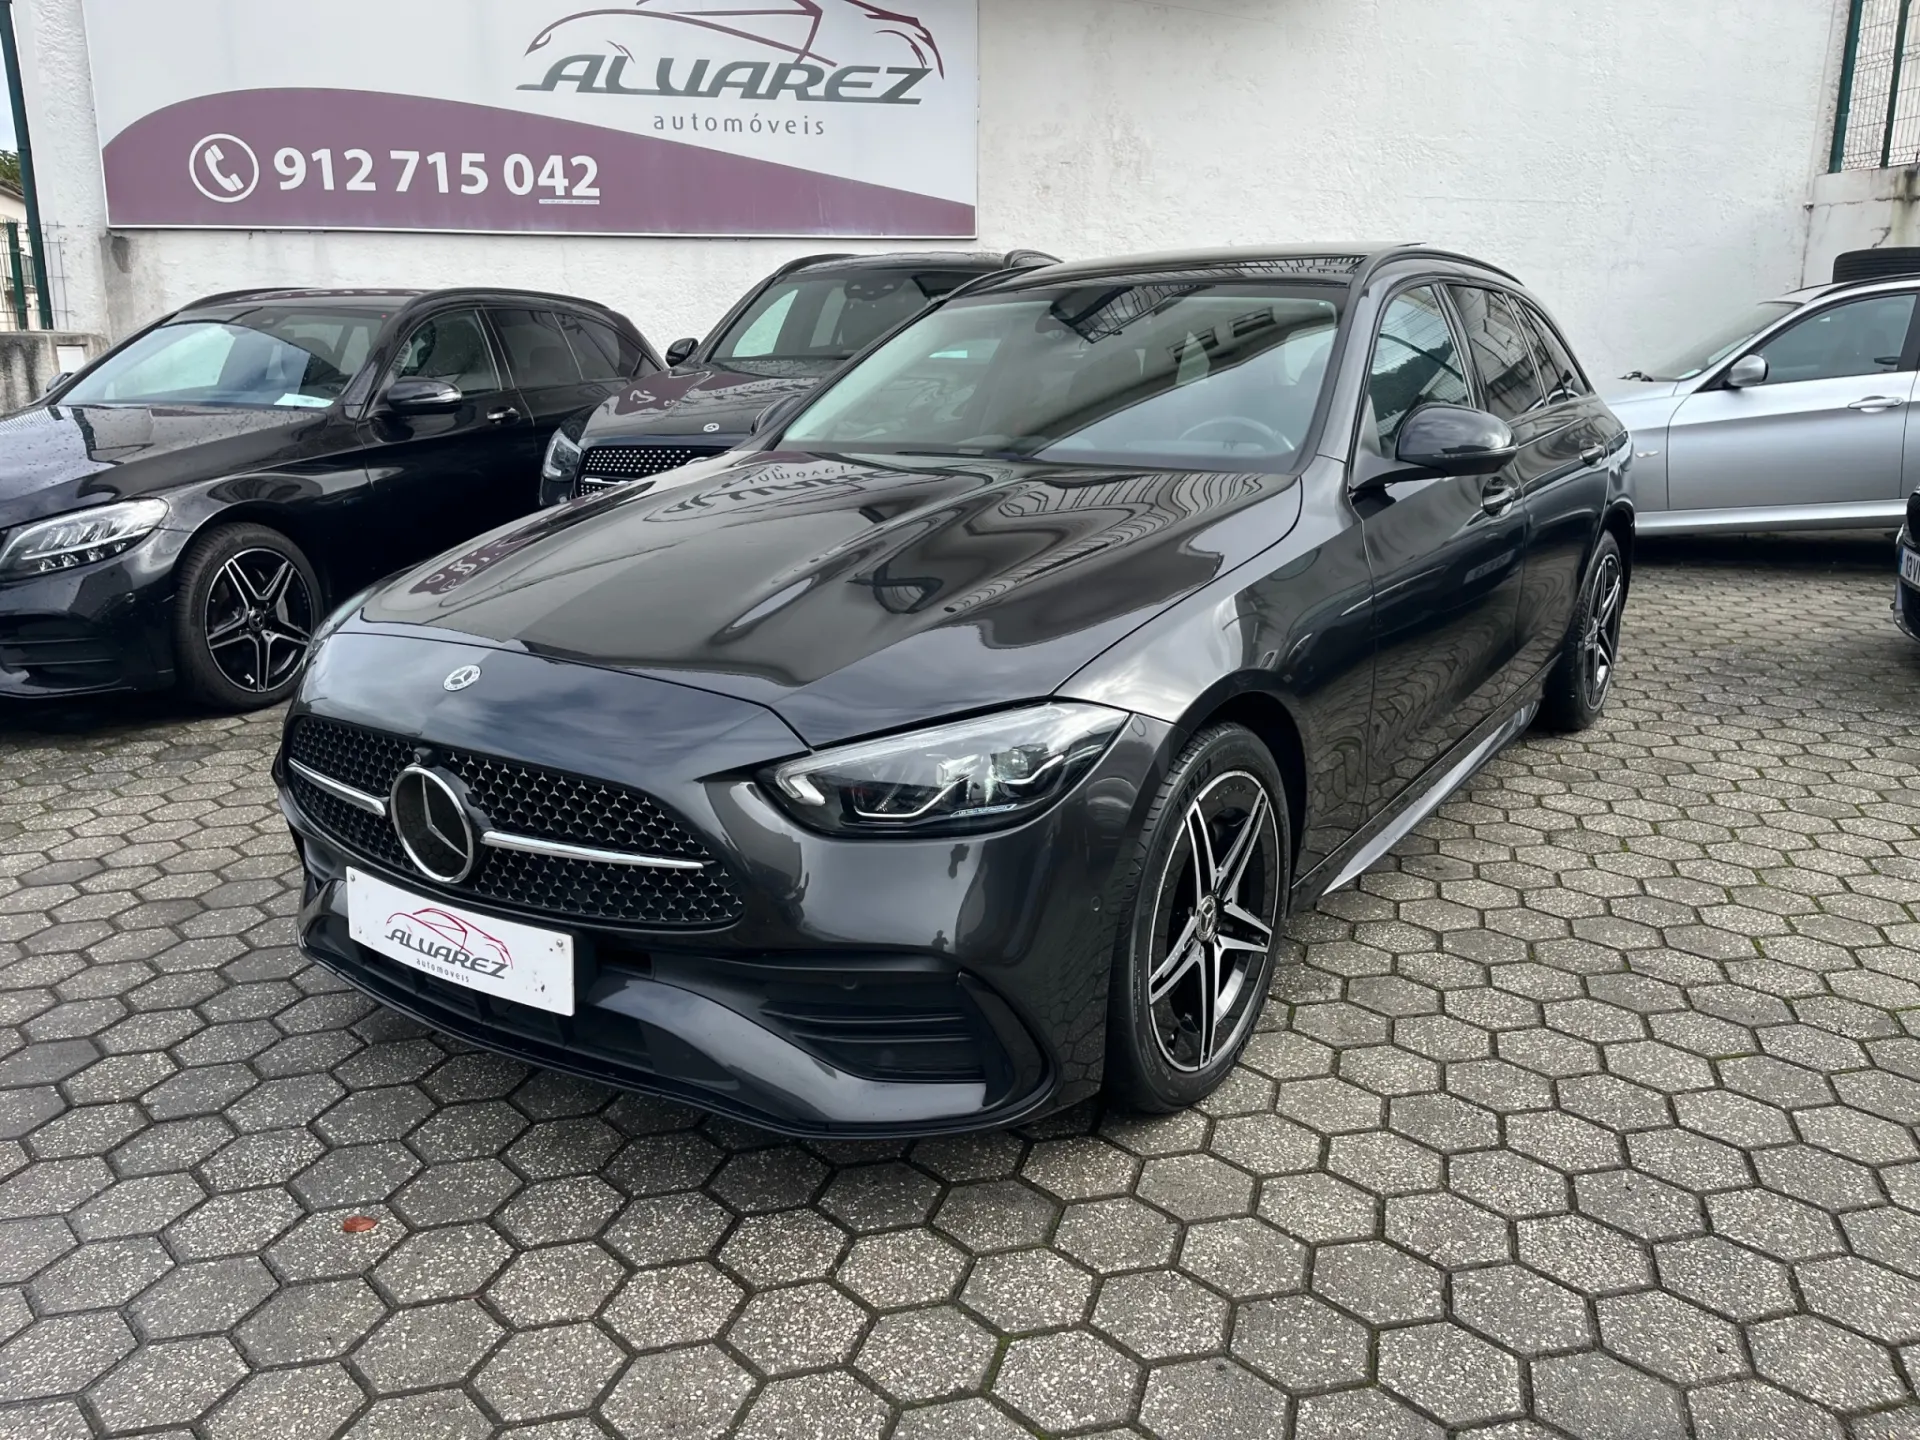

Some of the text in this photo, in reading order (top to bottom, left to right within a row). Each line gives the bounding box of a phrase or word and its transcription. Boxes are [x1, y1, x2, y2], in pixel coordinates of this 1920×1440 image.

[653, 112, 825, 136] automóveis
[274, 147, 601, 196] 912 715 042
